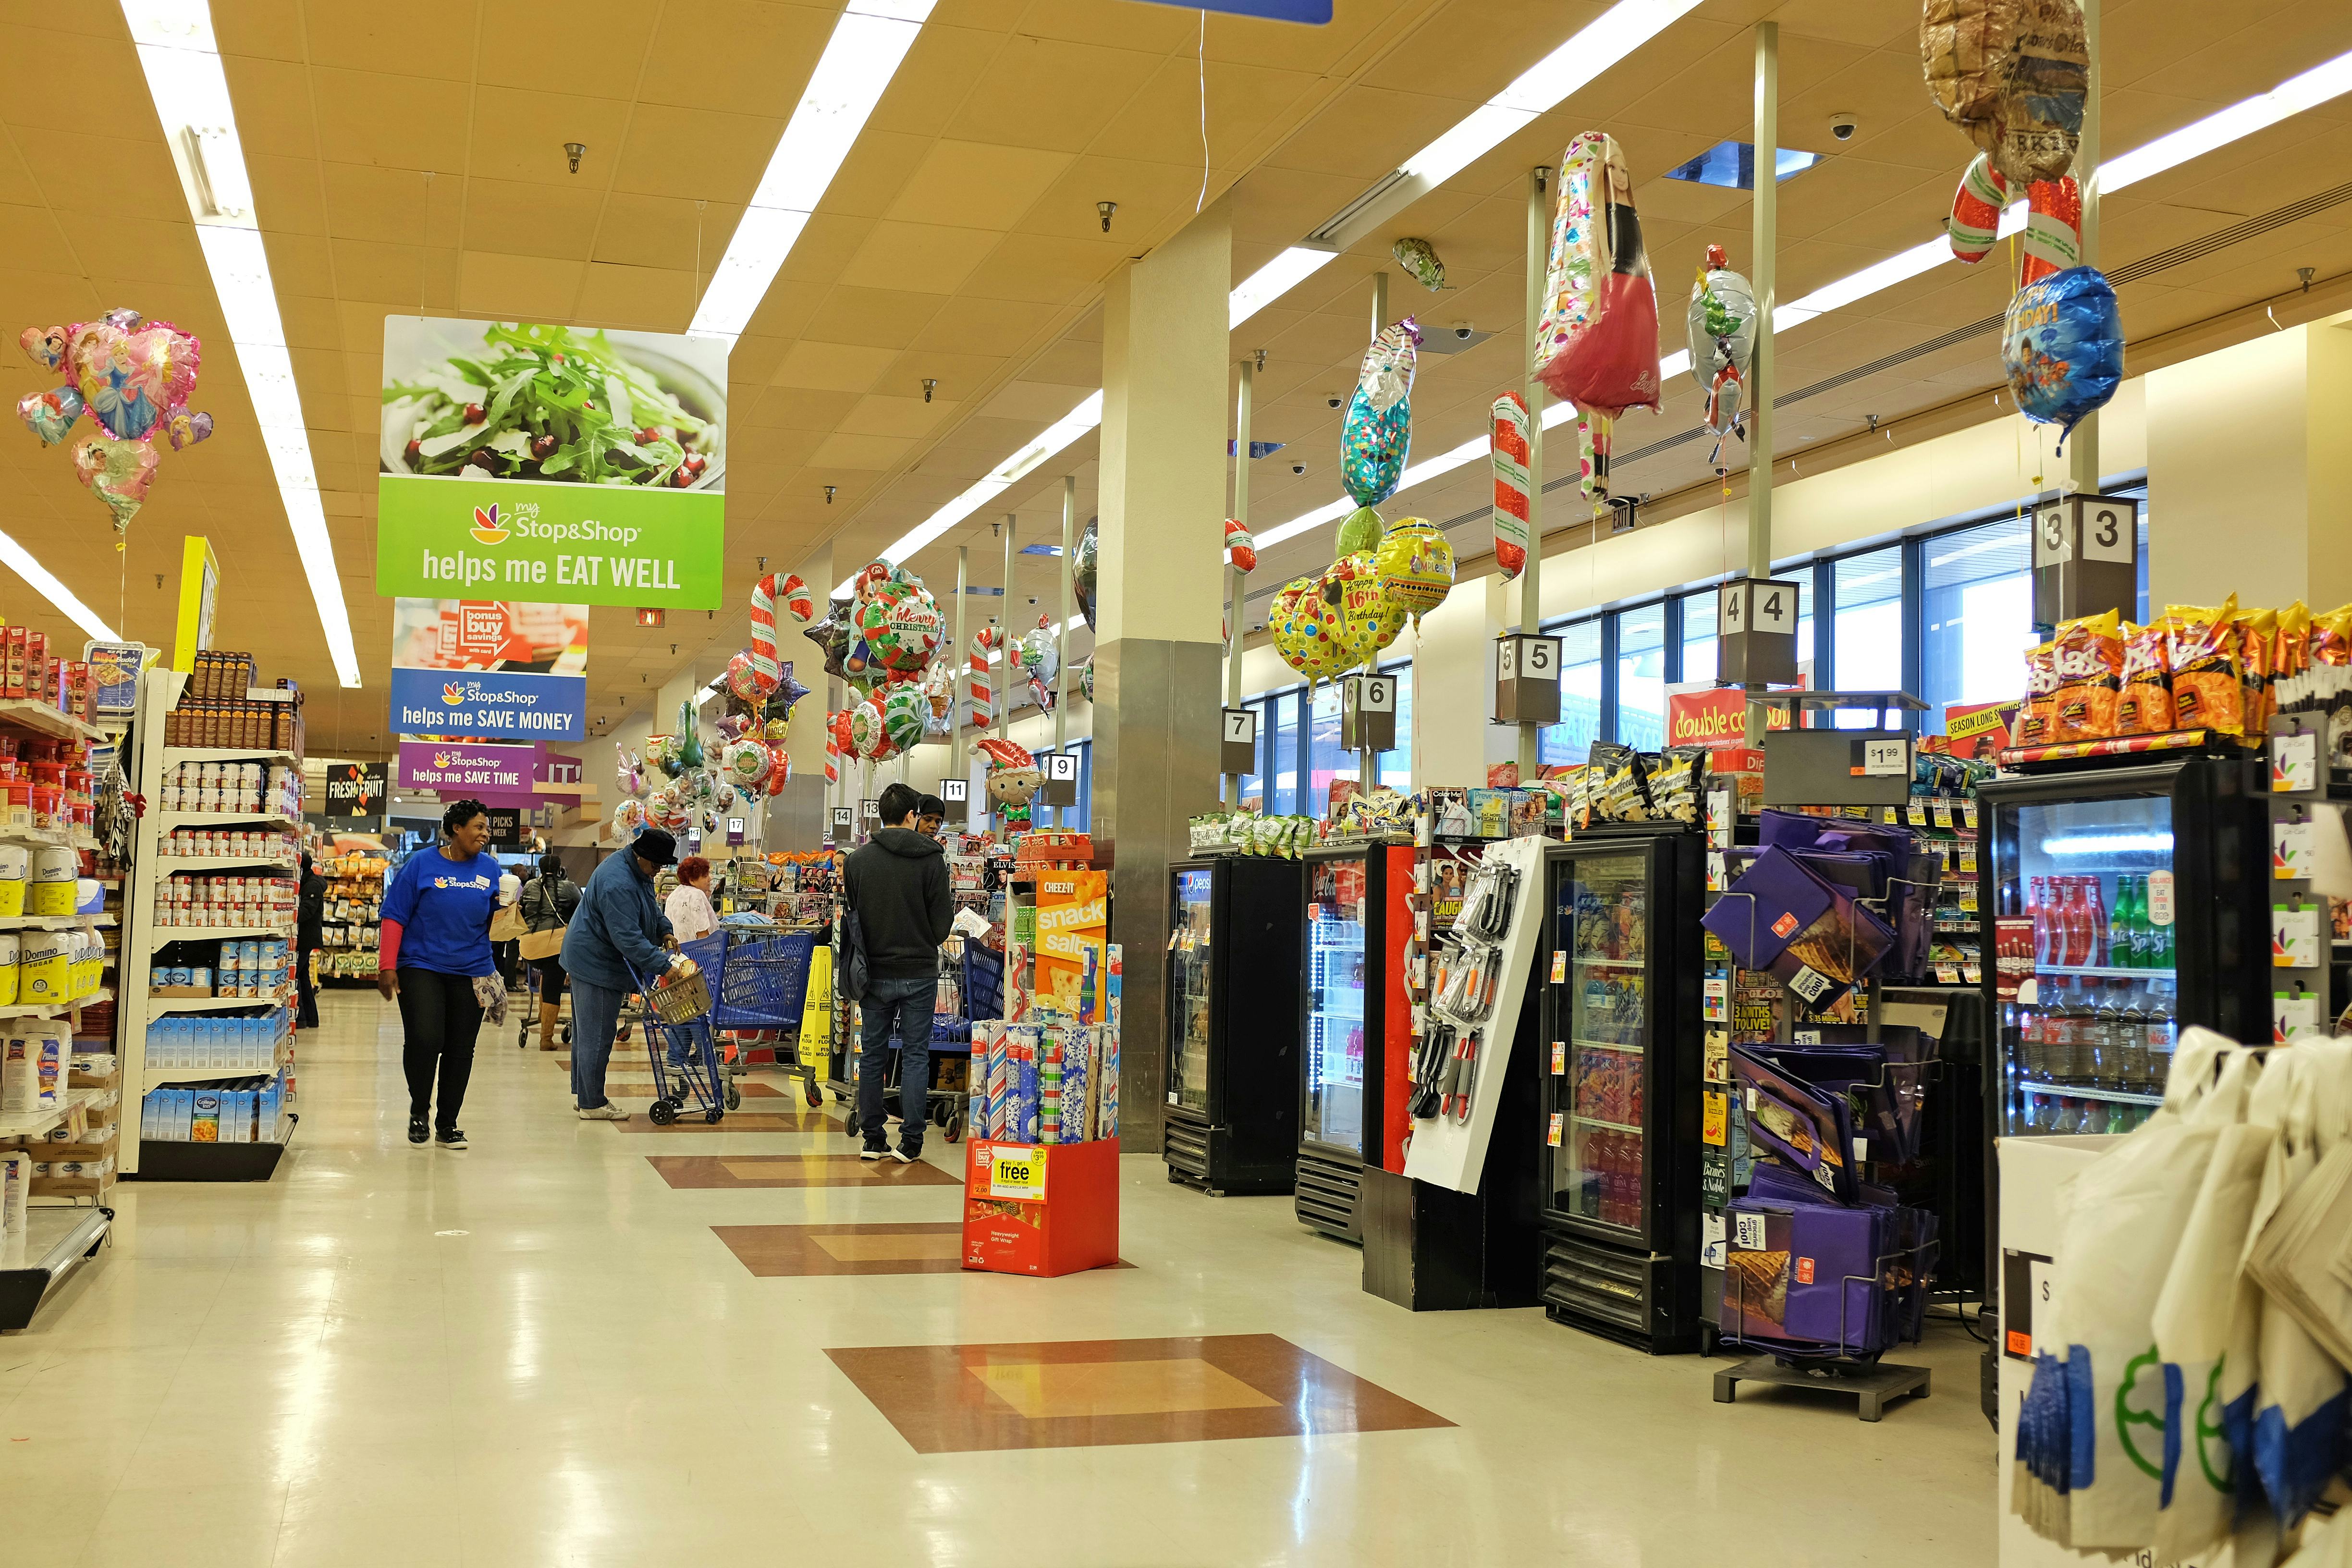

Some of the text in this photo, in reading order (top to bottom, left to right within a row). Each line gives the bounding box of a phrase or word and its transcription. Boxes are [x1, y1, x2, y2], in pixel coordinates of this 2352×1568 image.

[515, 502, 540, 517] my
[2046, 513, 2063, 551] 3
[2095, 510, 2119, 547] 3
[423, 549, 681, 589] helps me EAT WELL
[1346, 578, 1374, 591] Happy
[1345, 589, 1379, 609] 16th
[1727, 592, 1739, 622] 4
[1764, 592, 1783, 621] 4
[466, 611, 502, 620] bonus
[896, 607, 936, 628] Merry
[1348, 607, 1390, 622] Birthday!
[466, 619, 503, 635] buy
[890, 622, 939, 633] CHRISTMAS
[466, 633, 502, 642] savings
[1503, 646, 1511, 671] 5
[1531, 644, 1549, 669] 5
[466, 681, 481, 690] my
[1347, 681, 1353, 704] 6
[1369, 682, 1384, 703] 6
[403, 706, 573, 731] helps me SAVE MONEY
[1233, 716, 1245, 735] 7
[1675, 706, 1727, 739] double
[1950, 717, 1975, 734] SEASON
[1977, 711, 1993, 726] LONG
[548, 763, 582, 786] IT!
[1058, 760, 1067, 773] 9
[413, 769, 519, 785] helps me SAVE TIME
[329, 780, 384, 798] FRESH FRUIT
[949, 784, 962, 796] 11
[836, 811, 849, 821] 14
[866, 803, 879, 813] 13
[493, 816, 513, 827] PICKS
[731, 821, 741, 829] 17
[493, 828, 507, 837] WEEK
[689, 830, 698, 838] 19
[42, 866, 62, 876] Domino
[993, 861, 1016, 869] ELVIS
[1195, 874, 1212, 893] pepsi
[1039, 900, 1105, 930] snack
[25, 946, 58, 960] Domino
[1046, 934, 1099, 956] salt
[28, 959, 53, 968] SUGAR
[1798, 972, 1814, 990] groceries
[1809, 977, 1825, 997] cool
[1735, 1006, 1740, 1018] 3
[1735, 1018, 1770, 1030] TO LIVE!
[1706, 1042, 1725, 1052] Cheesecake
[1000, 1161, 1029, 1180] free
[1703, 1161, 1725, 1178] Barnes
[1739, 1221, 1751, 1245] cool
